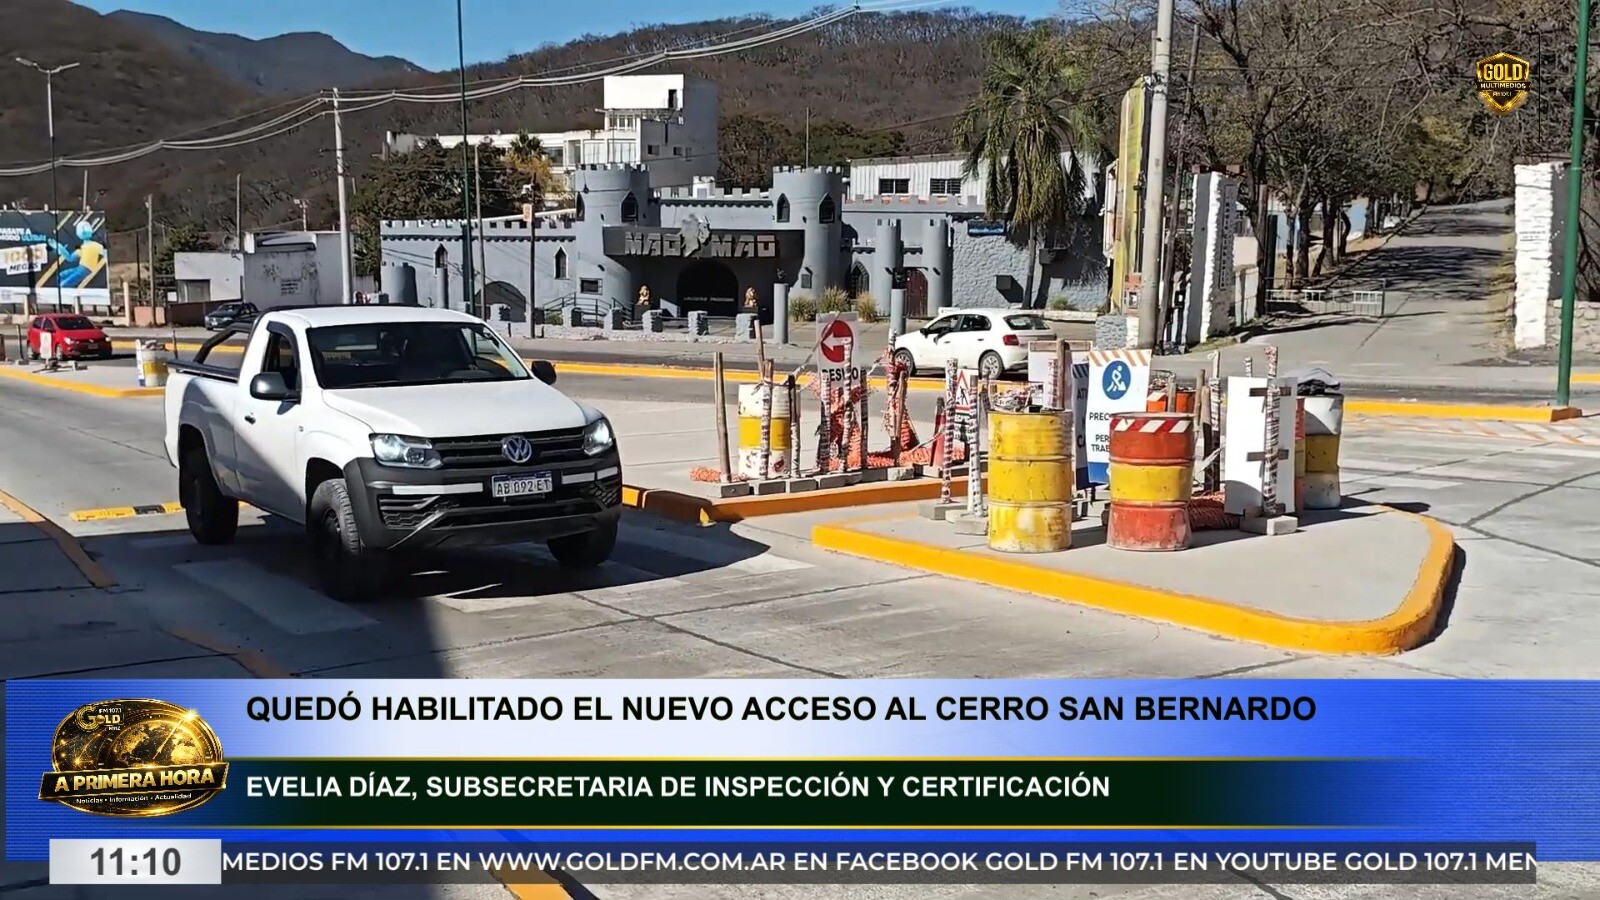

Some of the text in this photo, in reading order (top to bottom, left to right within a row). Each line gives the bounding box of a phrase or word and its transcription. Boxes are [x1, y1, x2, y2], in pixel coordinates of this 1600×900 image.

[625, 231, 776, 258] MAO MAO
[9, 263, 39, 272] MEGS
[822, 367, 859, 381] ESO
[1089, 412, 1110, 421] PREC
[1095, 434, 1110, 442] PER
[497, 479, 551, 495] AB 092 ET
